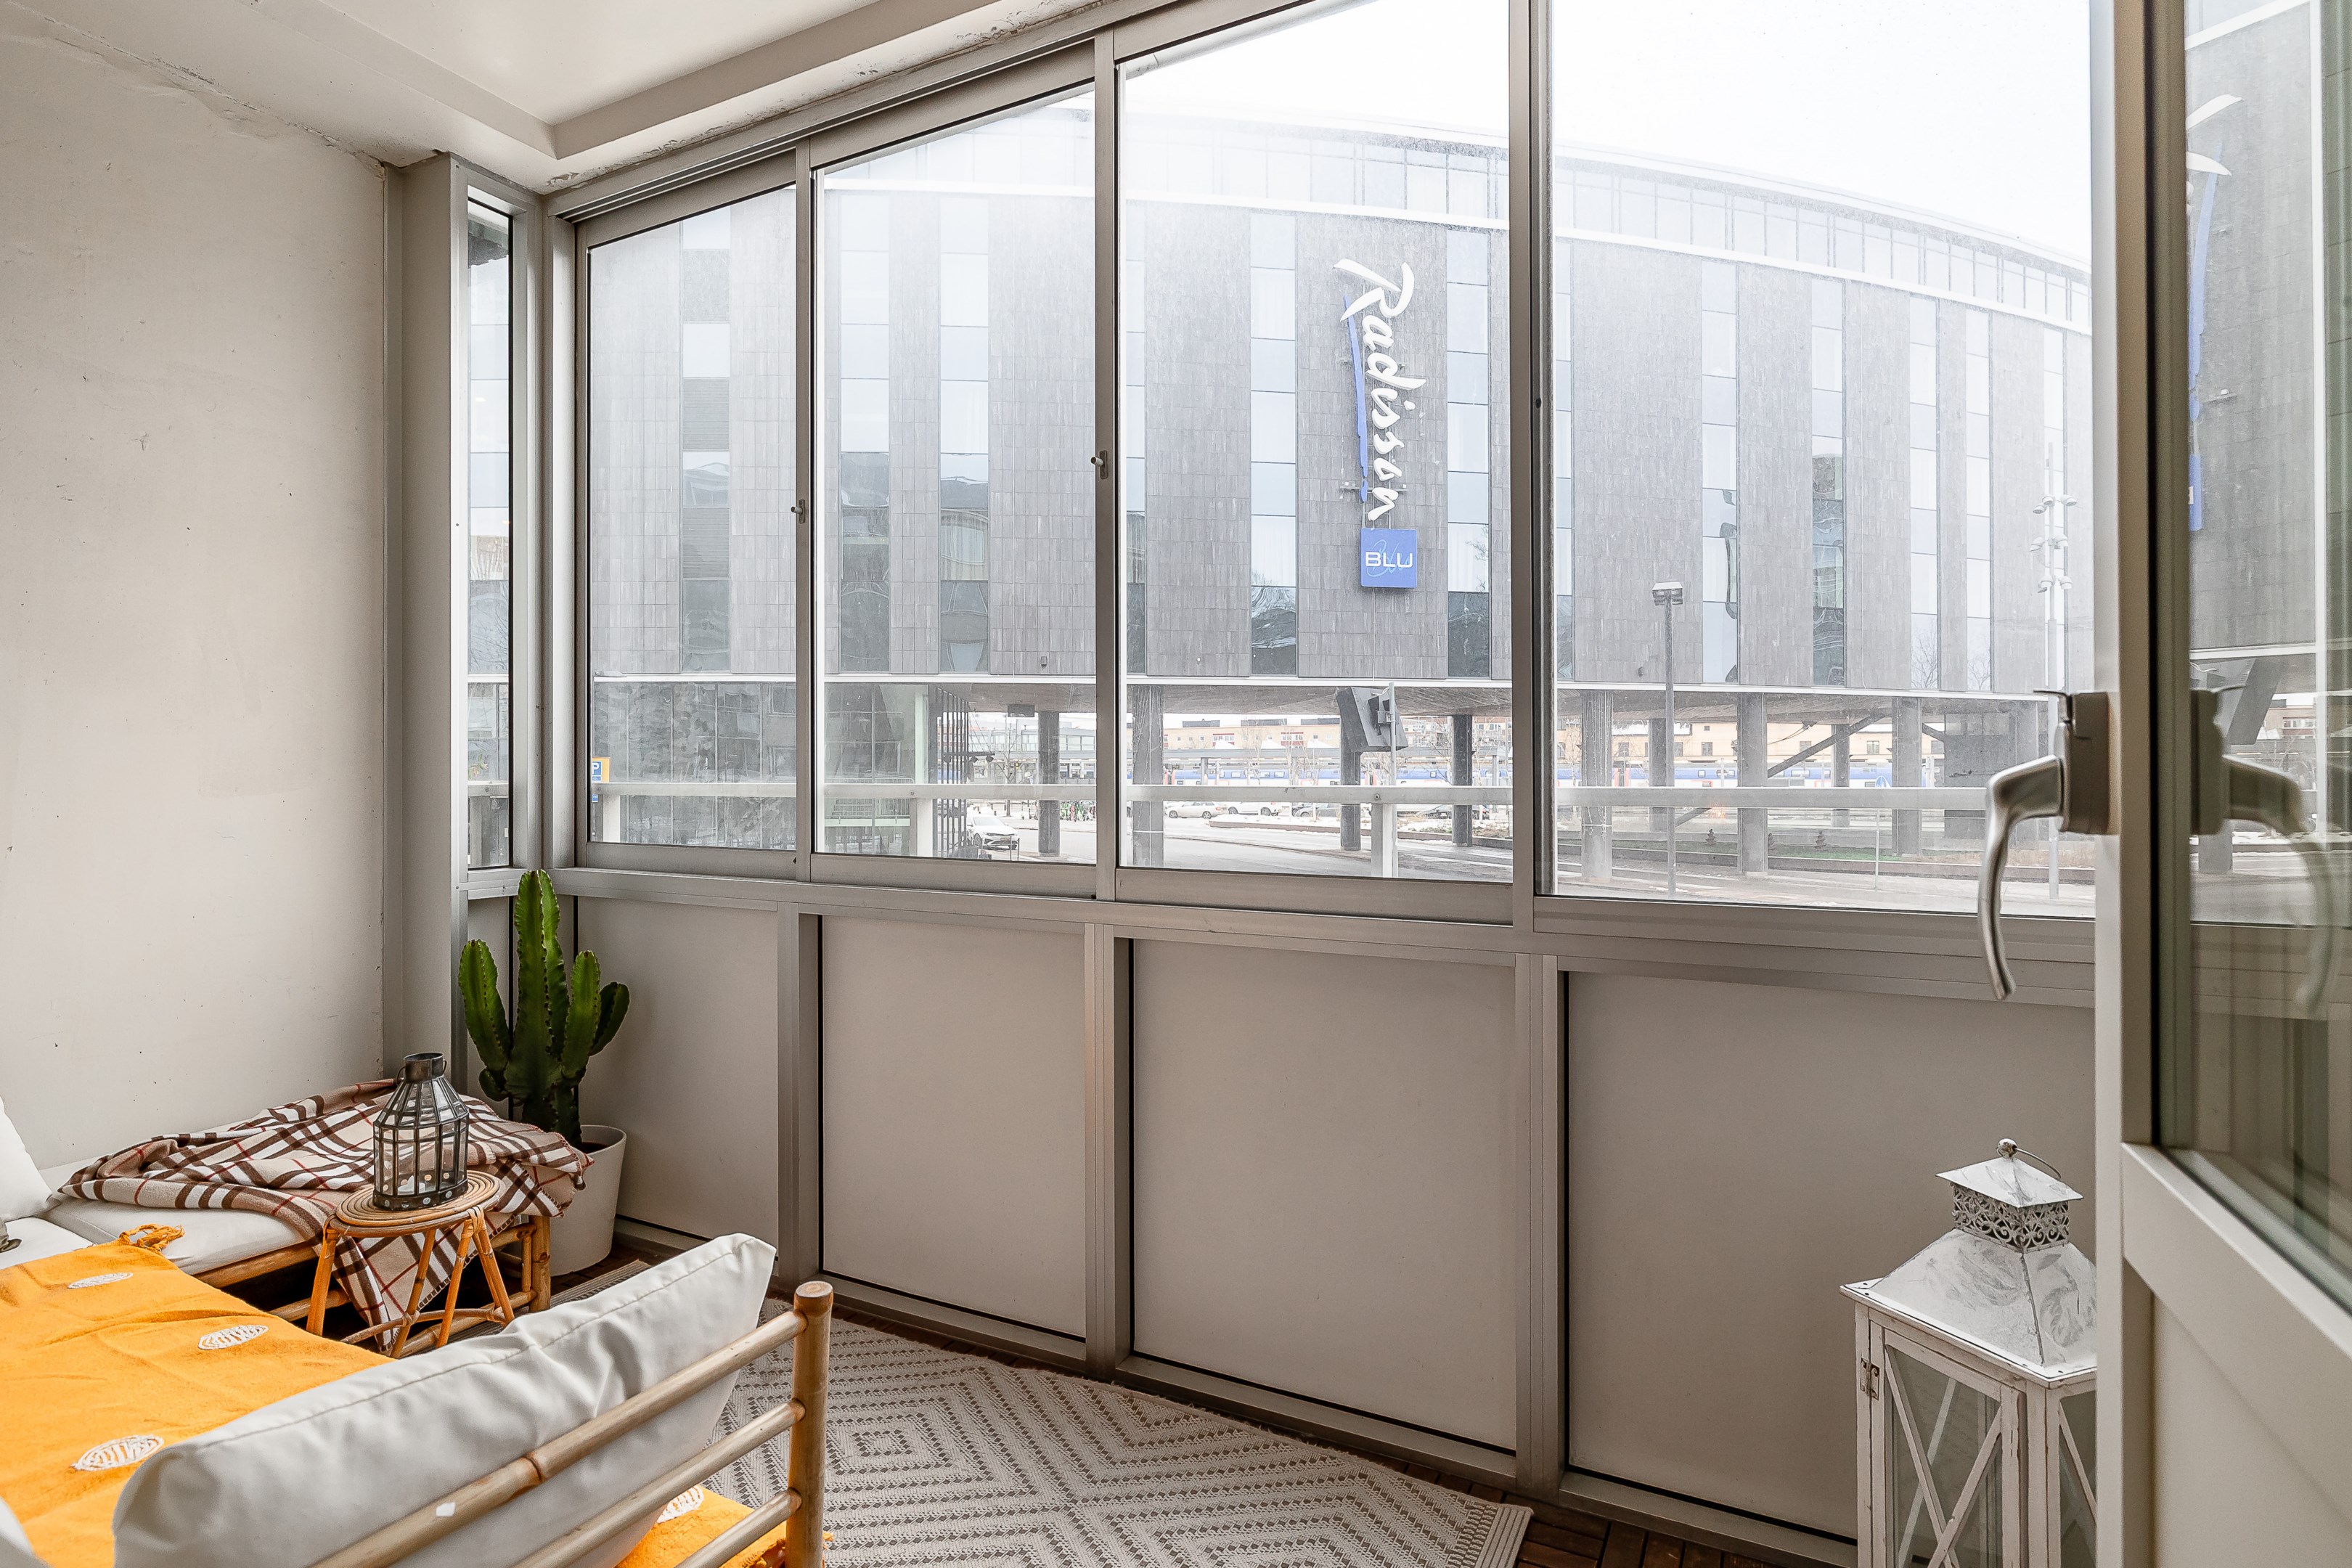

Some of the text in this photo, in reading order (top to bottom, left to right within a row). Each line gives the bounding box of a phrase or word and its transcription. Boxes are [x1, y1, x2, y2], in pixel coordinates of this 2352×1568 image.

[1334, 258, 1427, 521] Radisson
[1365, 551, 1413, 568] BLU
[592, 762, 600, 775] P
